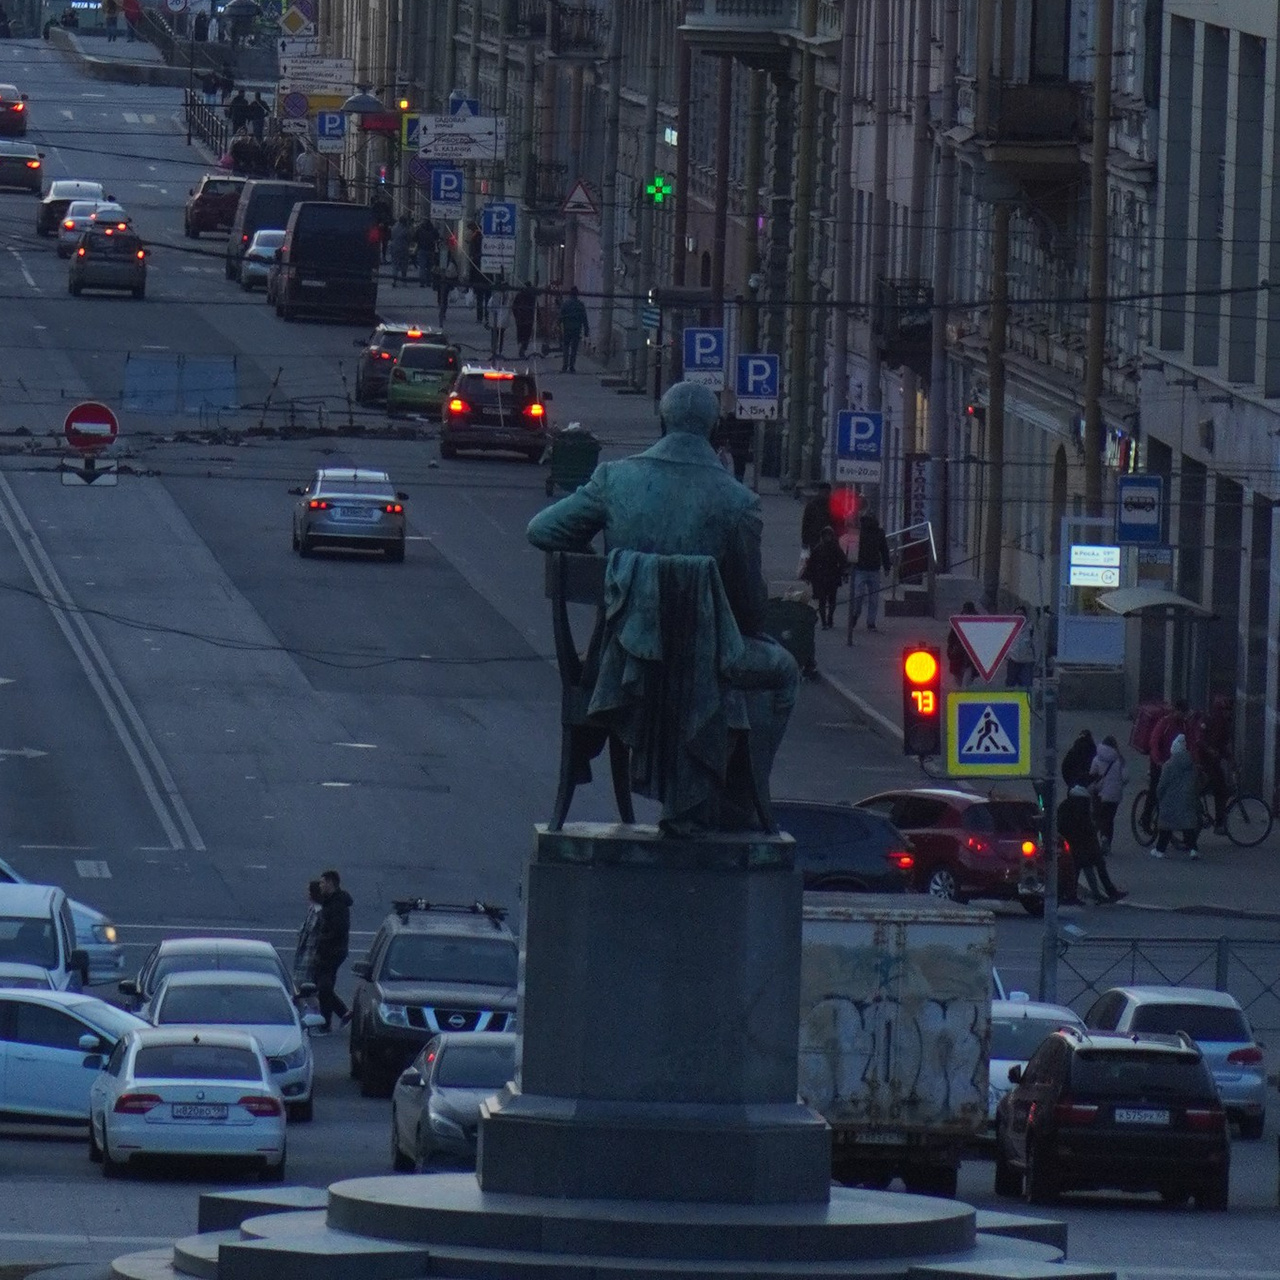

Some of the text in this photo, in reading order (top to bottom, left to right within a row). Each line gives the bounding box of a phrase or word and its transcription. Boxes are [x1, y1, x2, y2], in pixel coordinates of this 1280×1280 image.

[324, 114, 341, 136] P
[440, 173, 458, 199] P
[695, 332, 718, 365] P
[748, 358, 772, 393] P
[850, 416, 876, 452] P
[911, 691, 934, 713] 73
